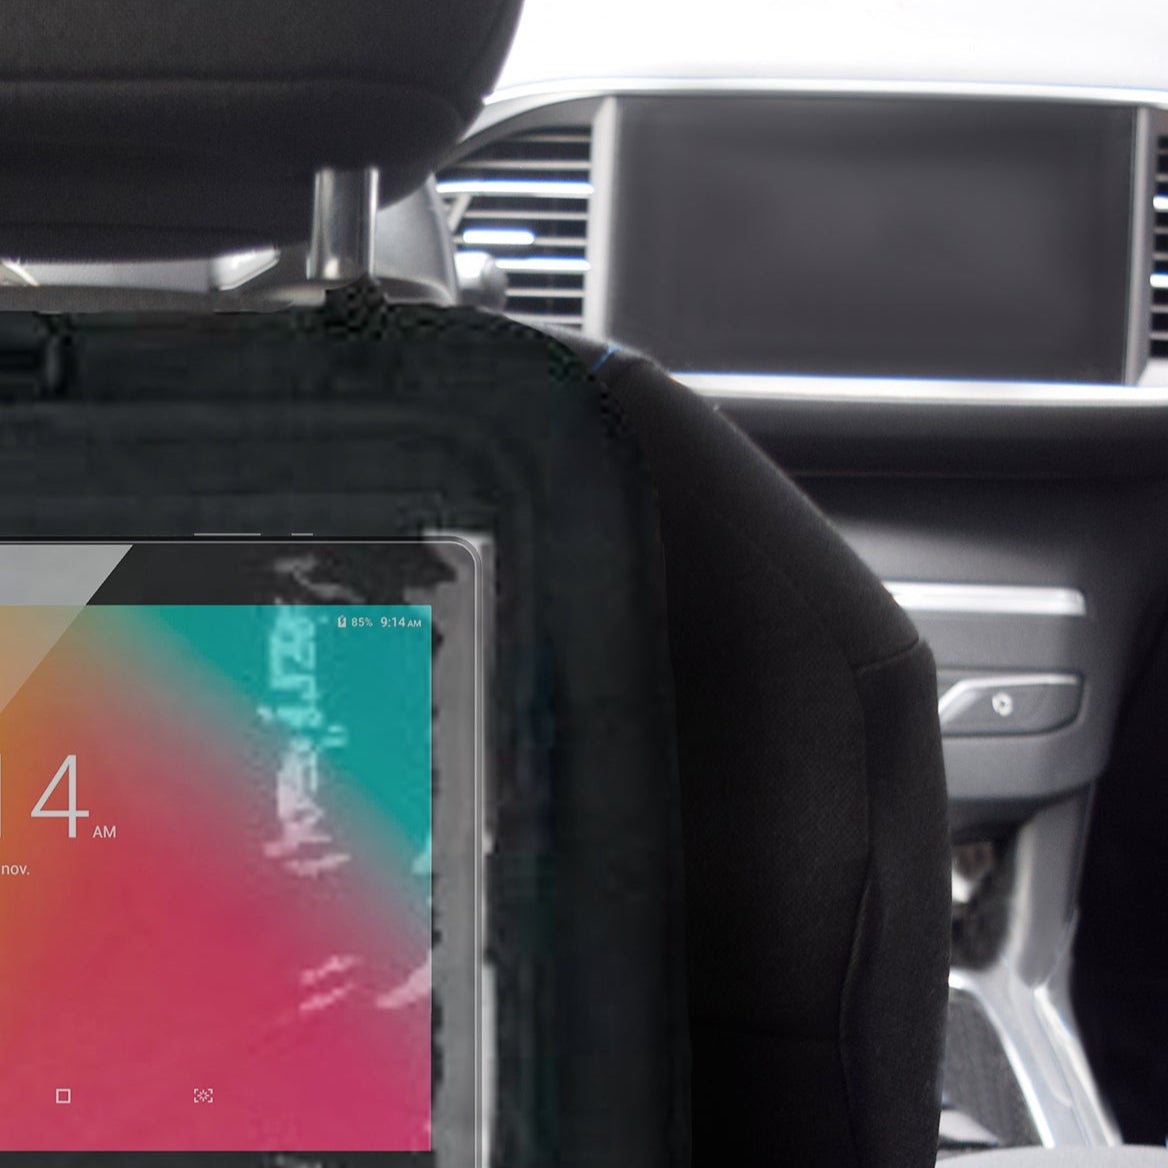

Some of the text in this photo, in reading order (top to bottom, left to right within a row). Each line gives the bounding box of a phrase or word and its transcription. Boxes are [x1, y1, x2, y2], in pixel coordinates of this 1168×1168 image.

[351, 616, 422, 628] 85% 9:14 AM
[93, 825, 117, 839] AM
[1, 864, 30, 876] nov.
